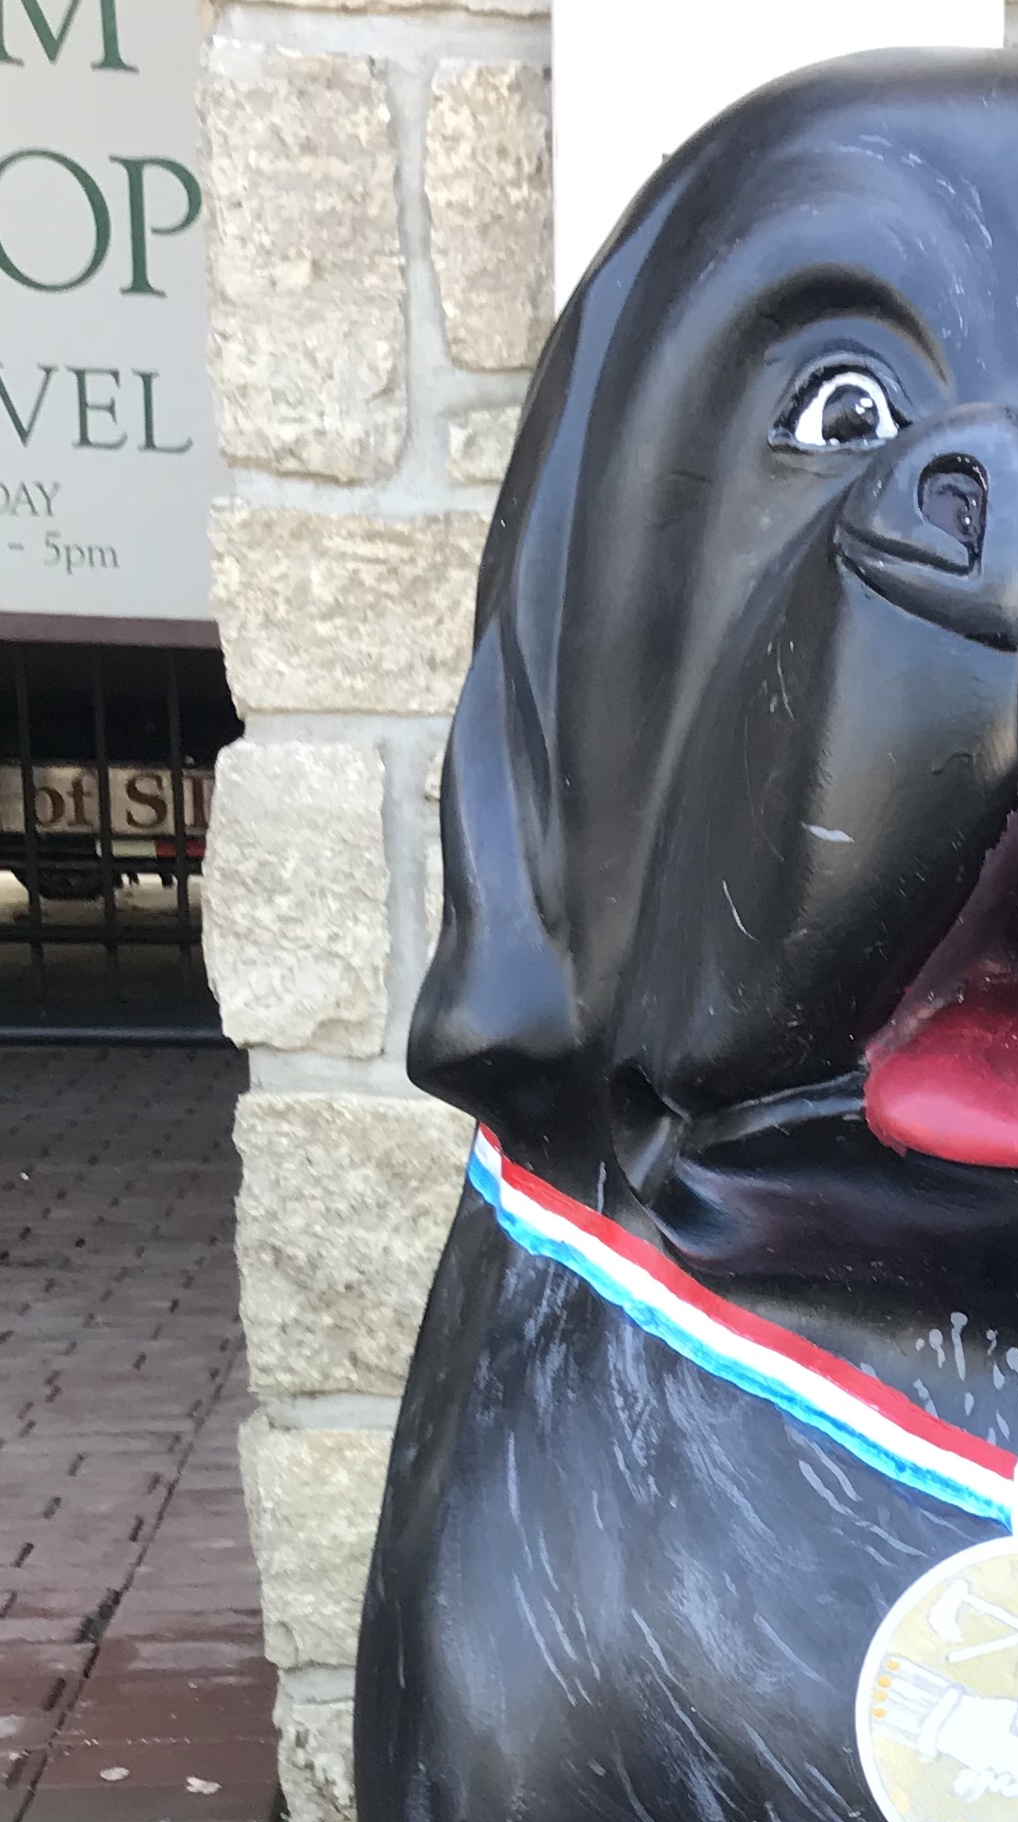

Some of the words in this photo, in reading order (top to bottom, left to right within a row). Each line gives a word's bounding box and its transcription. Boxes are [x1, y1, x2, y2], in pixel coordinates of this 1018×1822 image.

[0, 147, 202, 299] OP
[0, 363, 193, 455] VEL
[44, 529, 120, 576] 5pm
